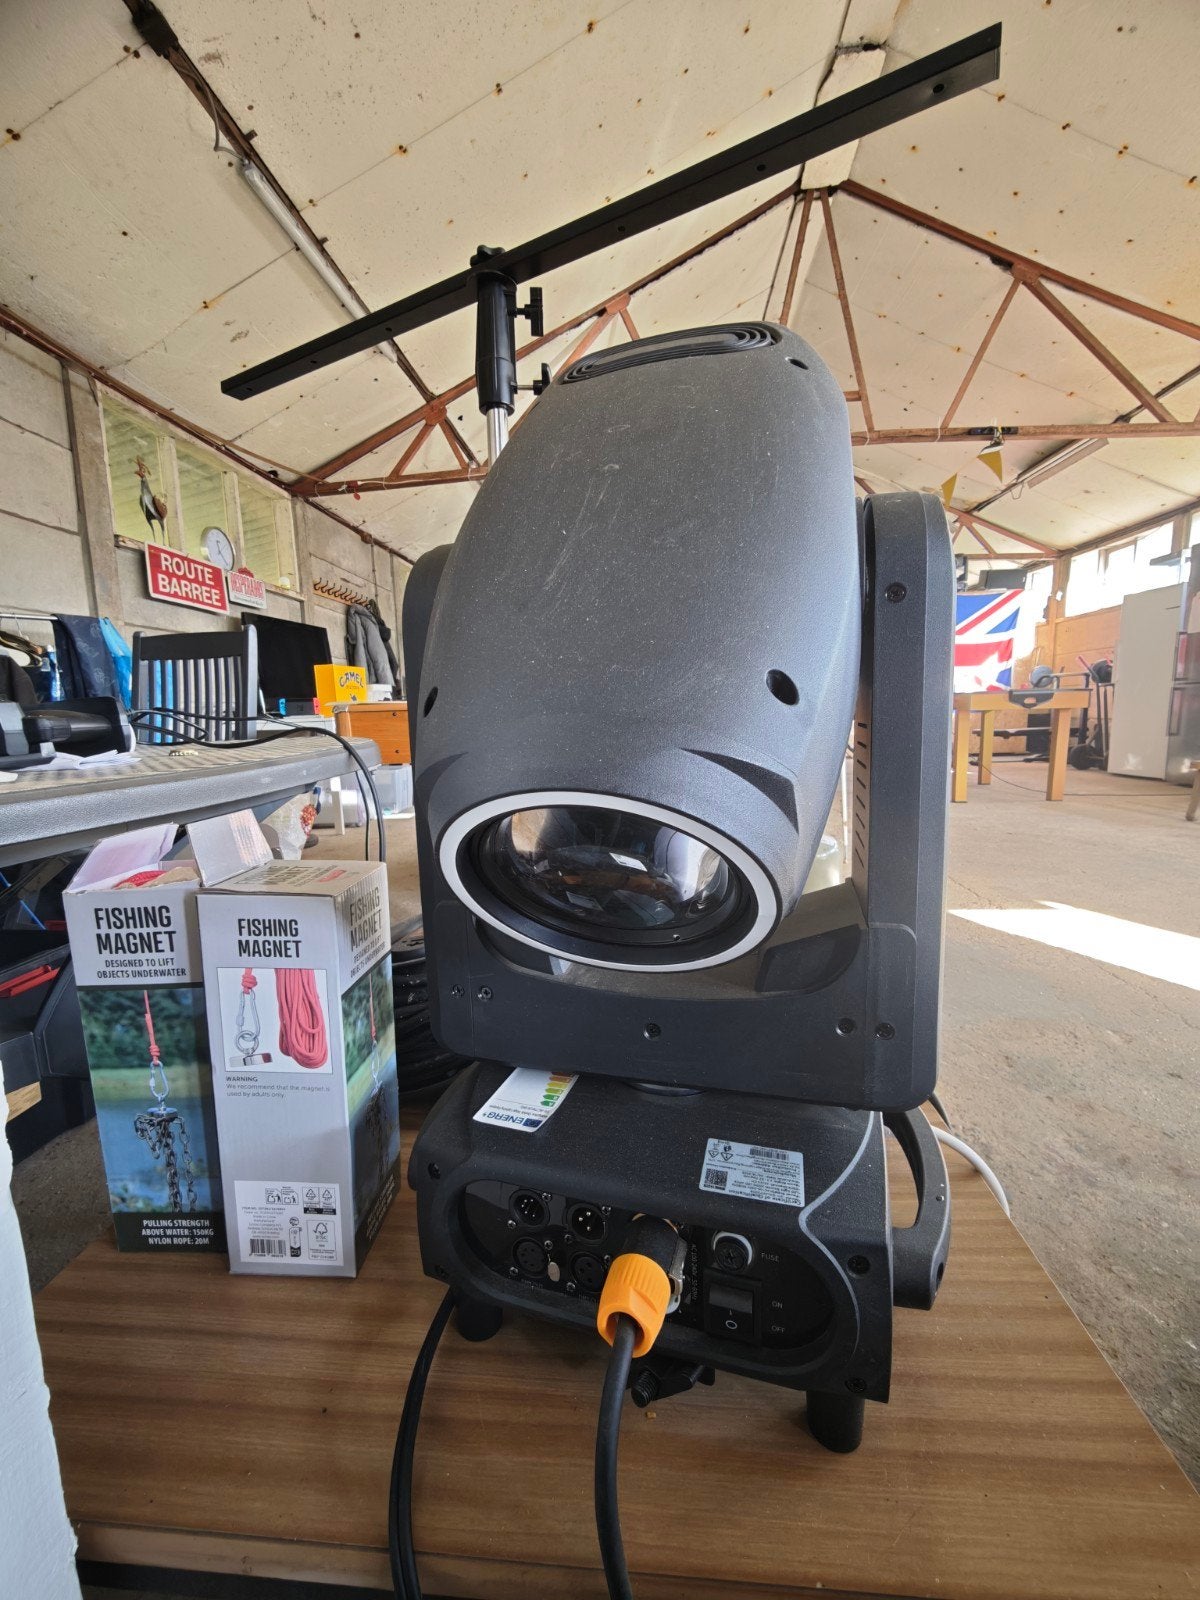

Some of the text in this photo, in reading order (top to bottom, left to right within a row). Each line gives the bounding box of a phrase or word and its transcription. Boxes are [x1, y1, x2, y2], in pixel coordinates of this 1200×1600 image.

[160, 553, 214, 585] ROUTE
[158, 573, 221, 606] BARREE
[339, 671, 363, 688] CAMEL
[94, 905, 172, 930] FISHING
[238, 918, 299, 937] FISHING
[350, 909, 382, 951] MAGNET
[96, 931, 177, 954] MAGNET
[238, 939, 302, 958] MAGNET
[105, 958, 175, 968] DESIGNED TO LIFT
[97, 968, 187, 979] OBJECTS UNDERWATER
[487, 1112, 524, 1124] ENERG
[772, 1196, 802, 1206] Certificate
[142, 1228, 214, 1236] ABOVE WATER: 150KG
[761, 1253, 780, 1262] FUSE
[772, 1301, 783, 1309] ON
